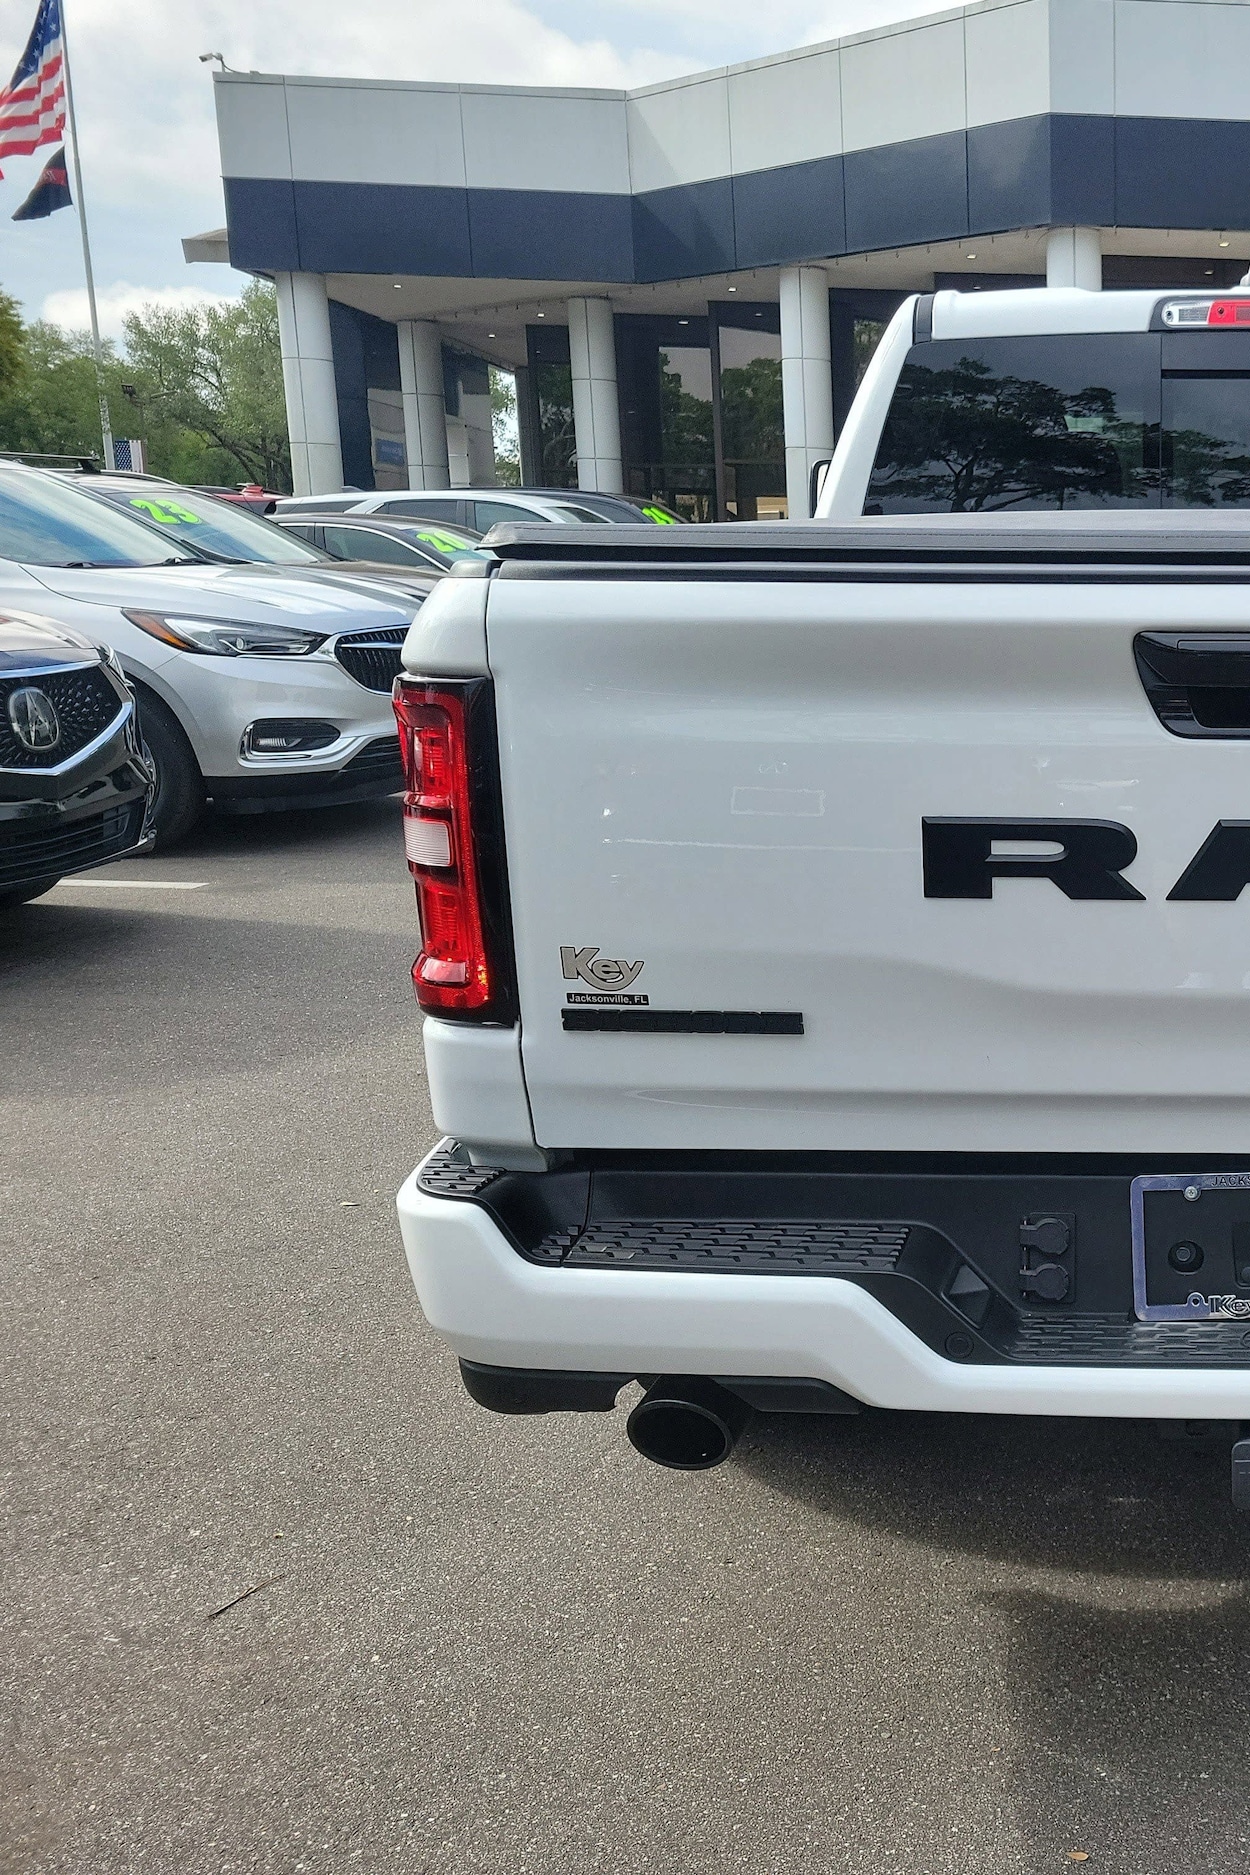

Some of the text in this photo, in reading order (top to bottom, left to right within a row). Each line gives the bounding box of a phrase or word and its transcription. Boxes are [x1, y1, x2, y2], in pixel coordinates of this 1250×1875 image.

[129, 499, 202, 524] 23
[560, 946, 645, 992] Key
[569, 994, 648, 1005] Jacksonville, FL
